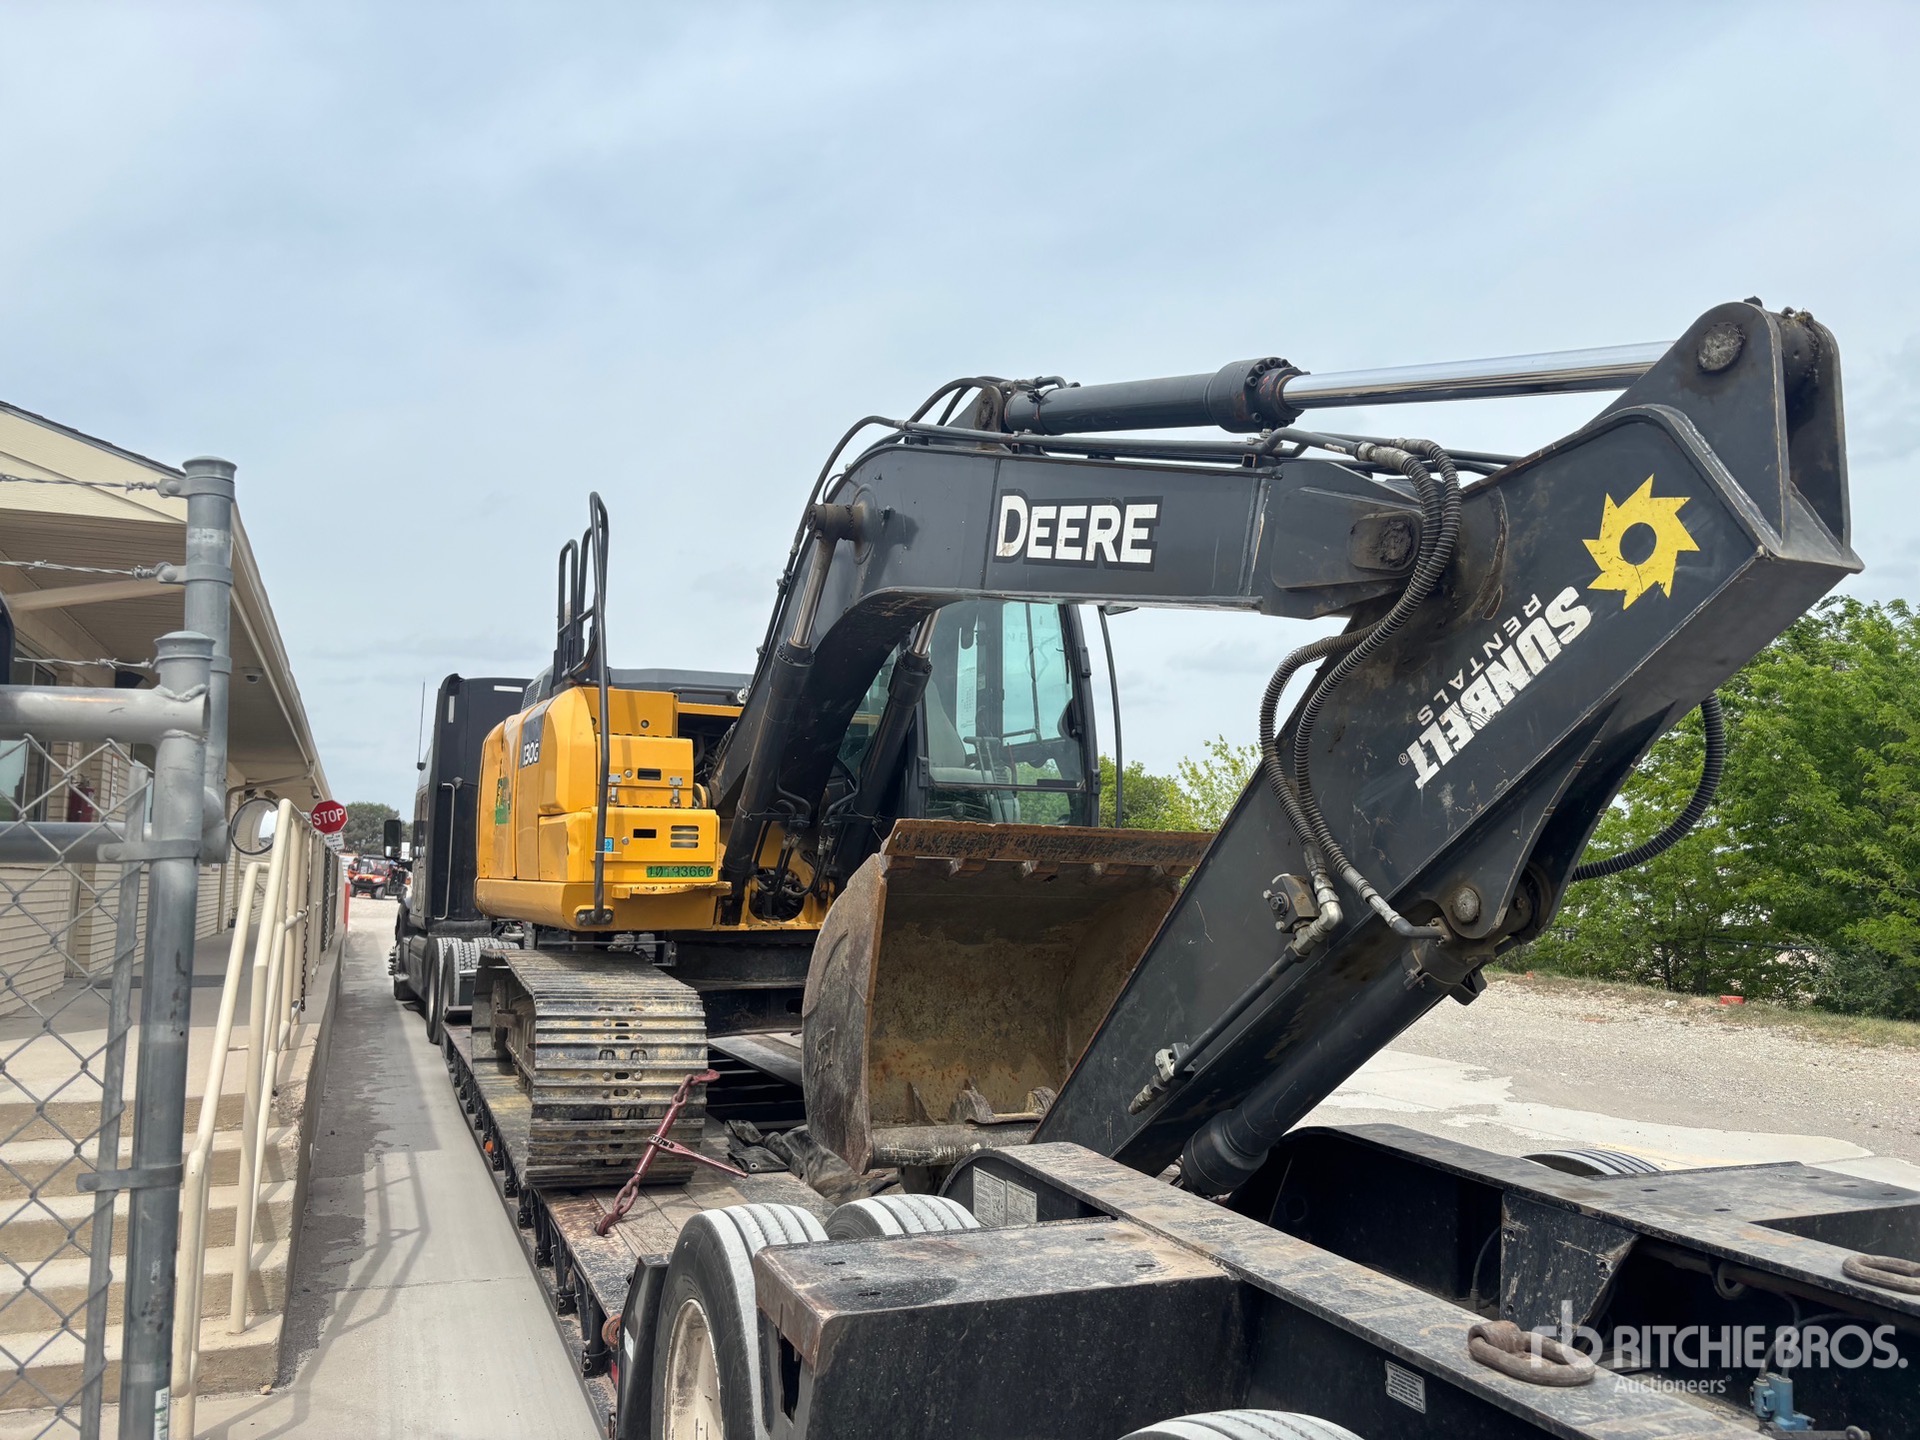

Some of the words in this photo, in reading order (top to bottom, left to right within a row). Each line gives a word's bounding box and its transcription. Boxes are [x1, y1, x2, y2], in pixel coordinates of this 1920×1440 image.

[996, 495, 1158, 564] DEERE
[1417, 593, 1543, 726] RENTALS
[312, 808, 345, 826] STOP
